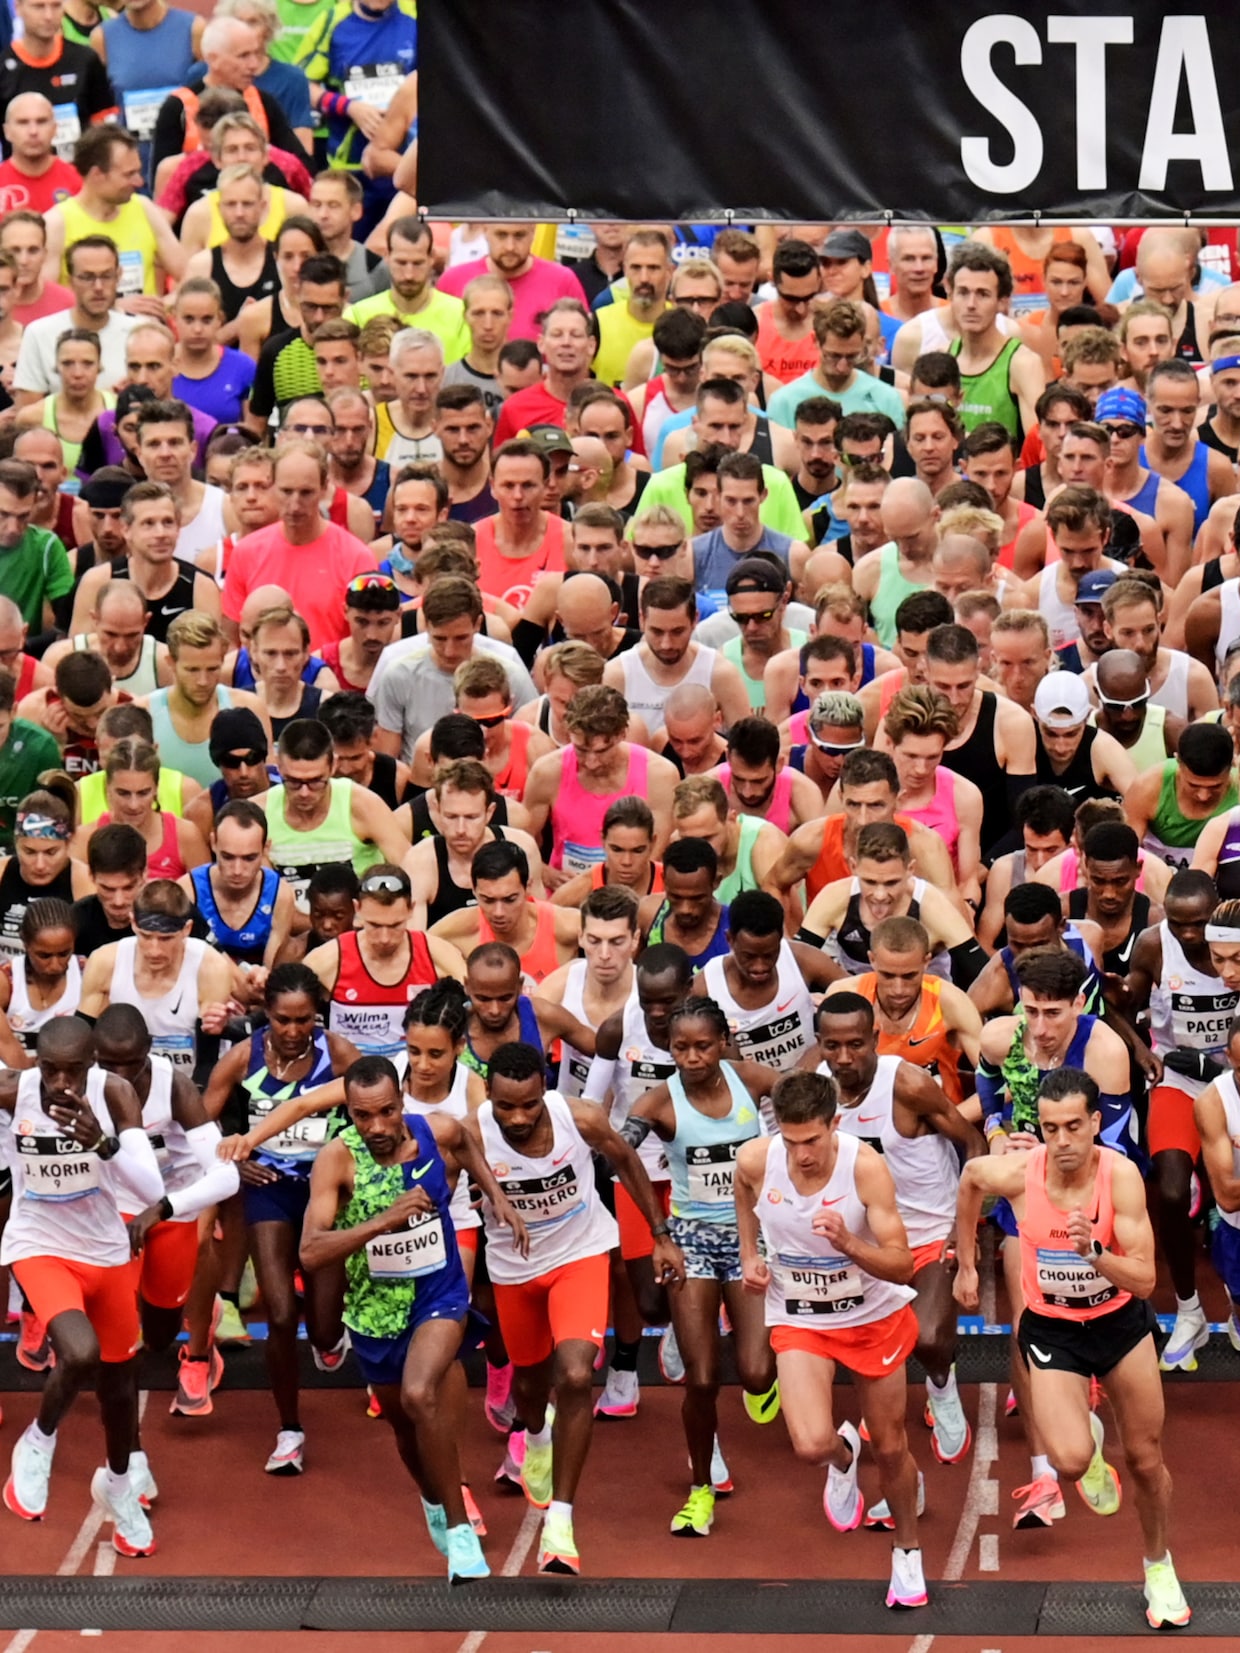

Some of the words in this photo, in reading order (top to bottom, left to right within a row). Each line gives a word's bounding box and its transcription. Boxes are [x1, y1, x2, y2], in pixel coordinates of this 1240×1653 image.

[1212, 997, 1237, 1010] tcs
[344, 1013, 389, 1024] Wilma
[1186, 1016, 1234, 1034] PACER
[768, 1020, 793, 1038] tcs
[1204, 1034, 1218, 1045] 82
[745, 1034, 805, 1063] RHANE
[56, 1138, 84, 1155] tcs
[25, 1164, 37, 1179] J.
[41, 1162, 92, 1179] KORIR
[54, 1179, 62, 1190] 9
[541, 1173, 567, 1191] tcs
[543, 1208, 550, 1216] 4
[372, 1230, 439, 1258] NEGEWO
[405, 1255, 413, 1266] 5
[792, 1270, 849, 1286] BUTTER
[815, 1287, 829, 1297] 19
[1072, 1284, 1086, 1293] 18
[1088, 1290, 1111, 1307] tcs
[832, 1300, 857, 1312] tcs
